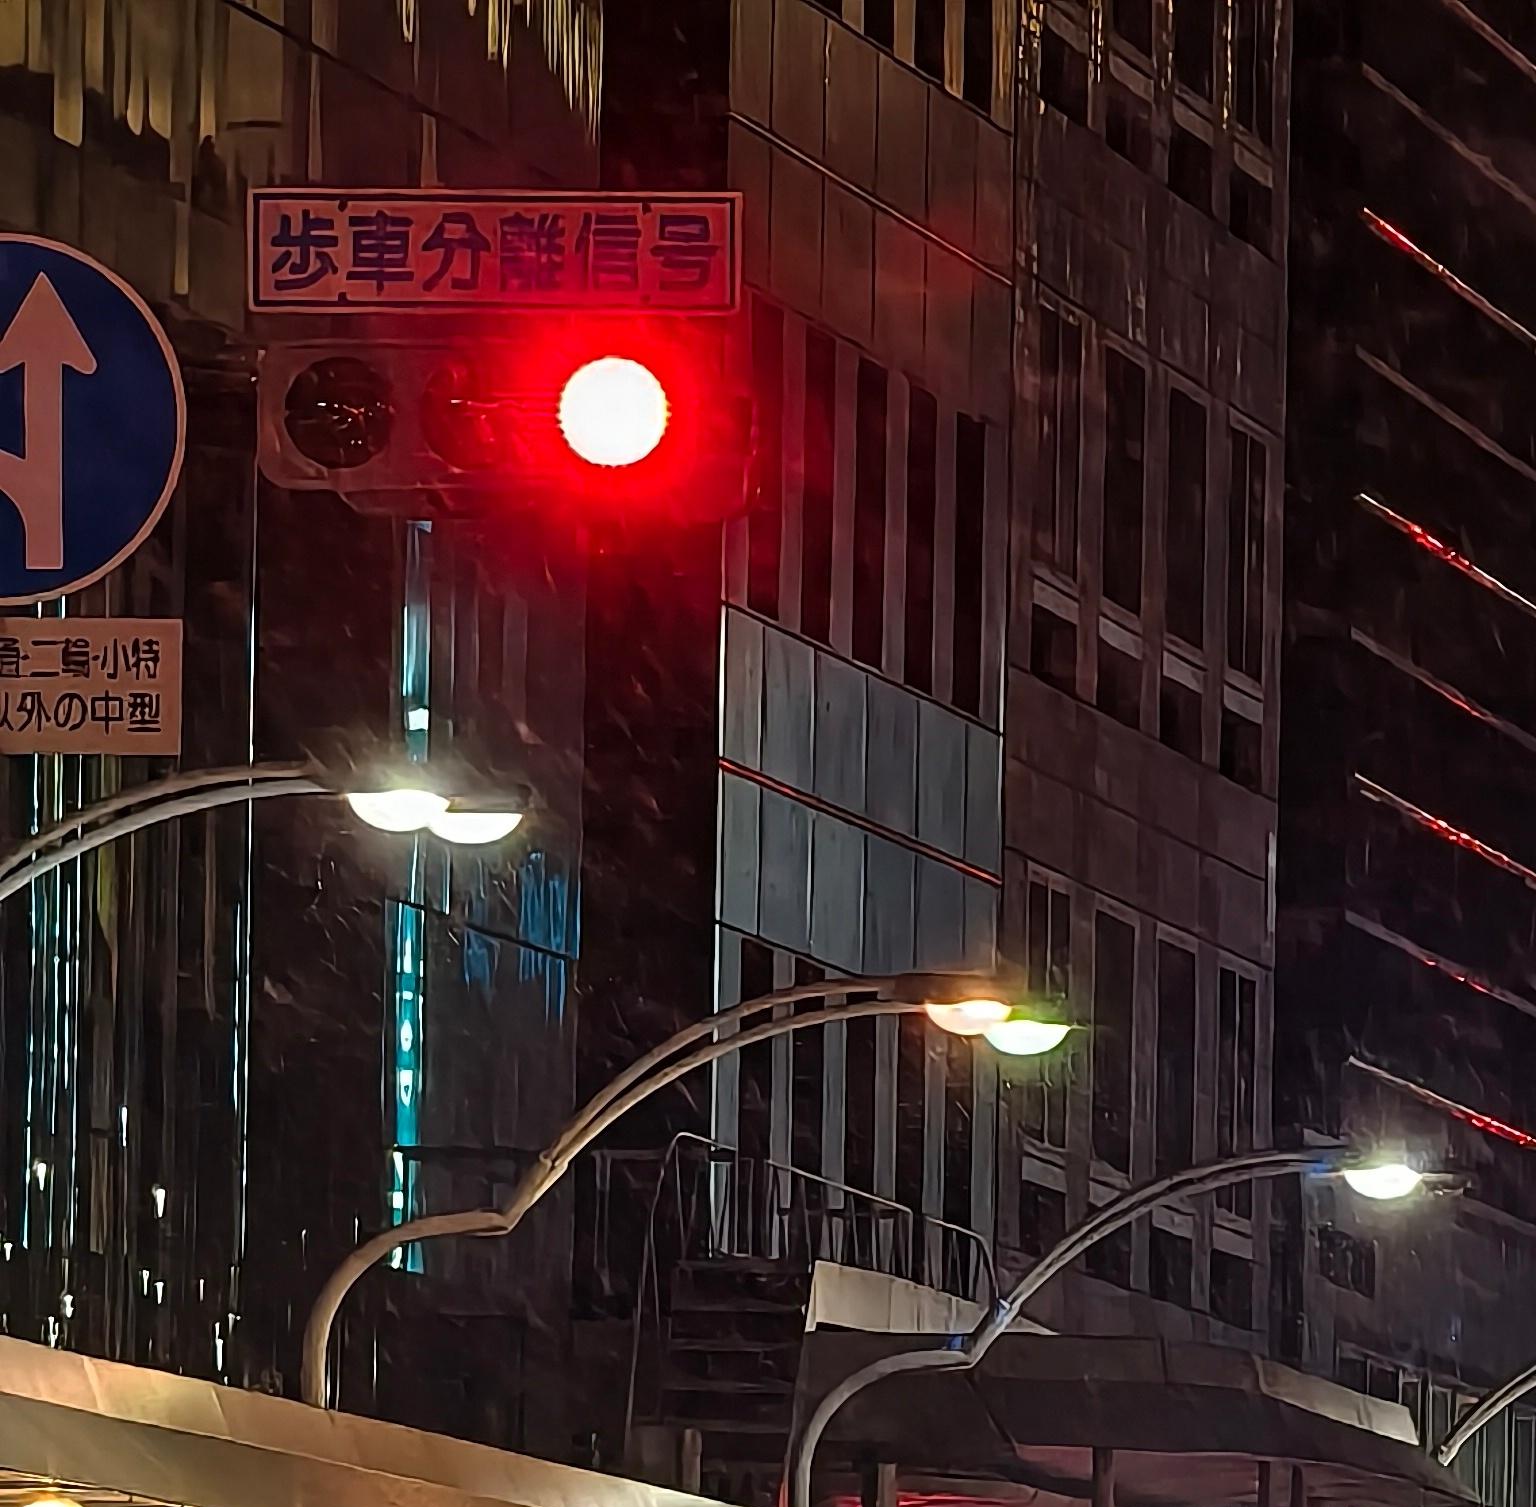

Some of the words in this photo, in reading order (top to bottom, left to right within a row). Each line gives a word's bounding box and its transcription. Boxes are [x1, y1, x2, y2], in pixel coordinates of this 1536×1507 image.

[270, 208, 719, 293] 歩車分離信号
